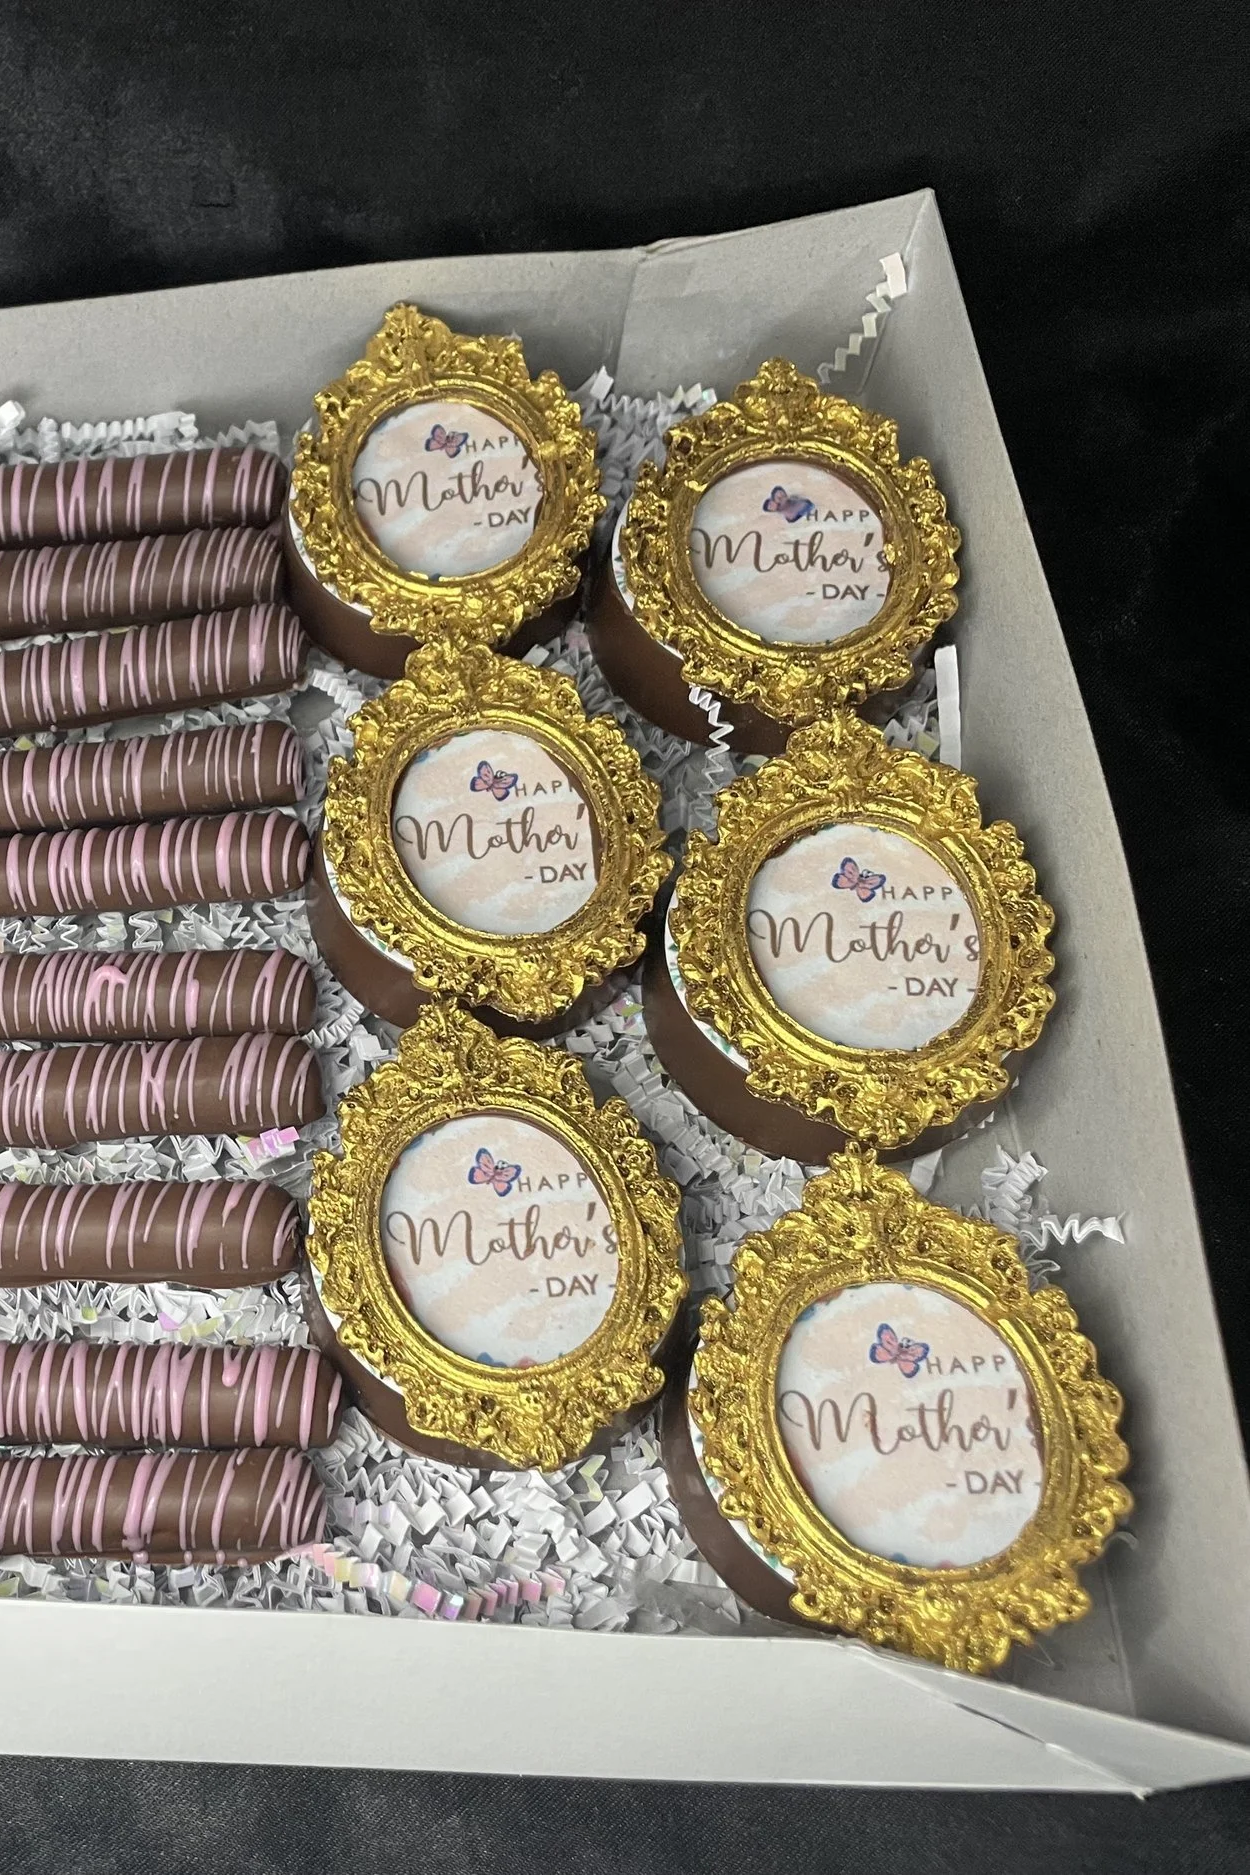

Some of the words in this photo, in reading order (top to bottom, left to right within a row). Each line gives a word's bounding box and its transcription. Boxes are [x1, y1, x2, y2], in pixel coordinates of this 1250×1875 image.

[806, 509, 870, 522] HAPP
[690, 530, 887, 573] Mother's
[395, 803, 586, 860] Mother'
[882, 886, 953, 900] HAPP
[749, 910, 979, 963] Mother's
[517, 1172, 588, 1193] HAPP
[386, 1202, 617, 1266] Mother's
[926, 1355, 1007, 1375] HAPP
